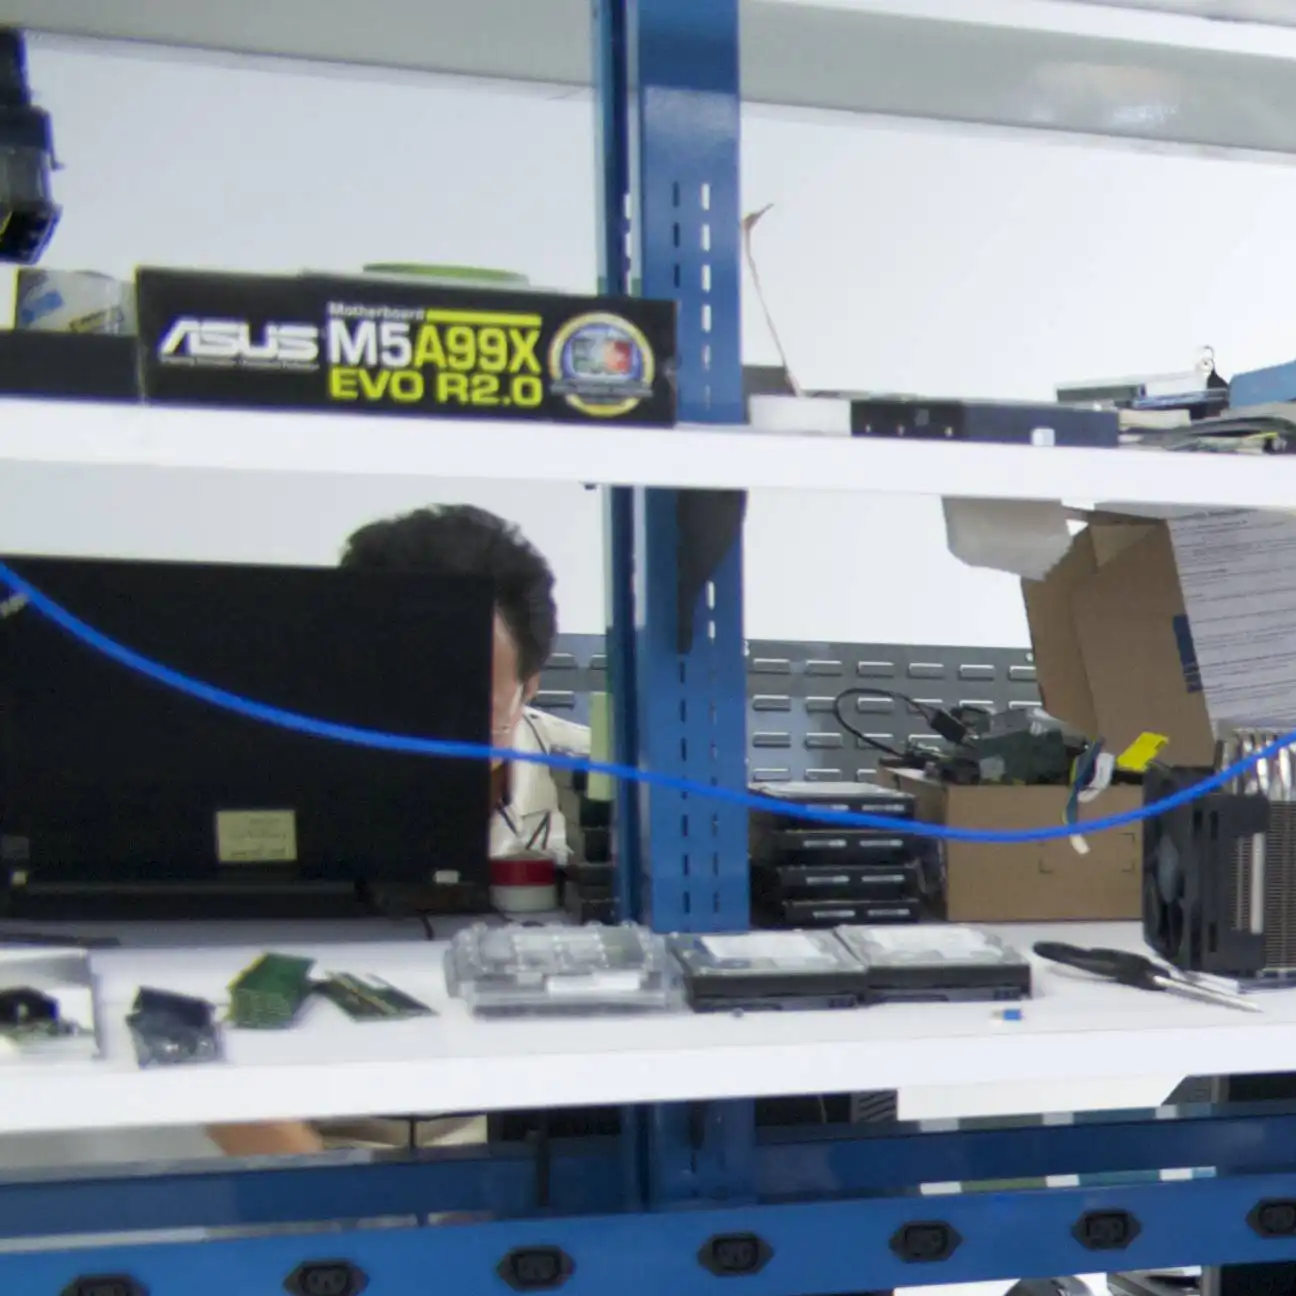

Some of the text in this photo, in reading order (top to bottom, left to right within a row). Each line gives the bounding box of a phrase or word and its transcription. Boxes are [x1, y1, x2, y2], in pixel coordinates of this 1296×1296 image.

[327, 301, 425, 320] Motherboard
[158, 317, 320, 361] ASUS
[327, 317, 542, 374] M5A99X
[330, 366, 425, 403] EVO
[436, 371, 543, 408] R2.0
